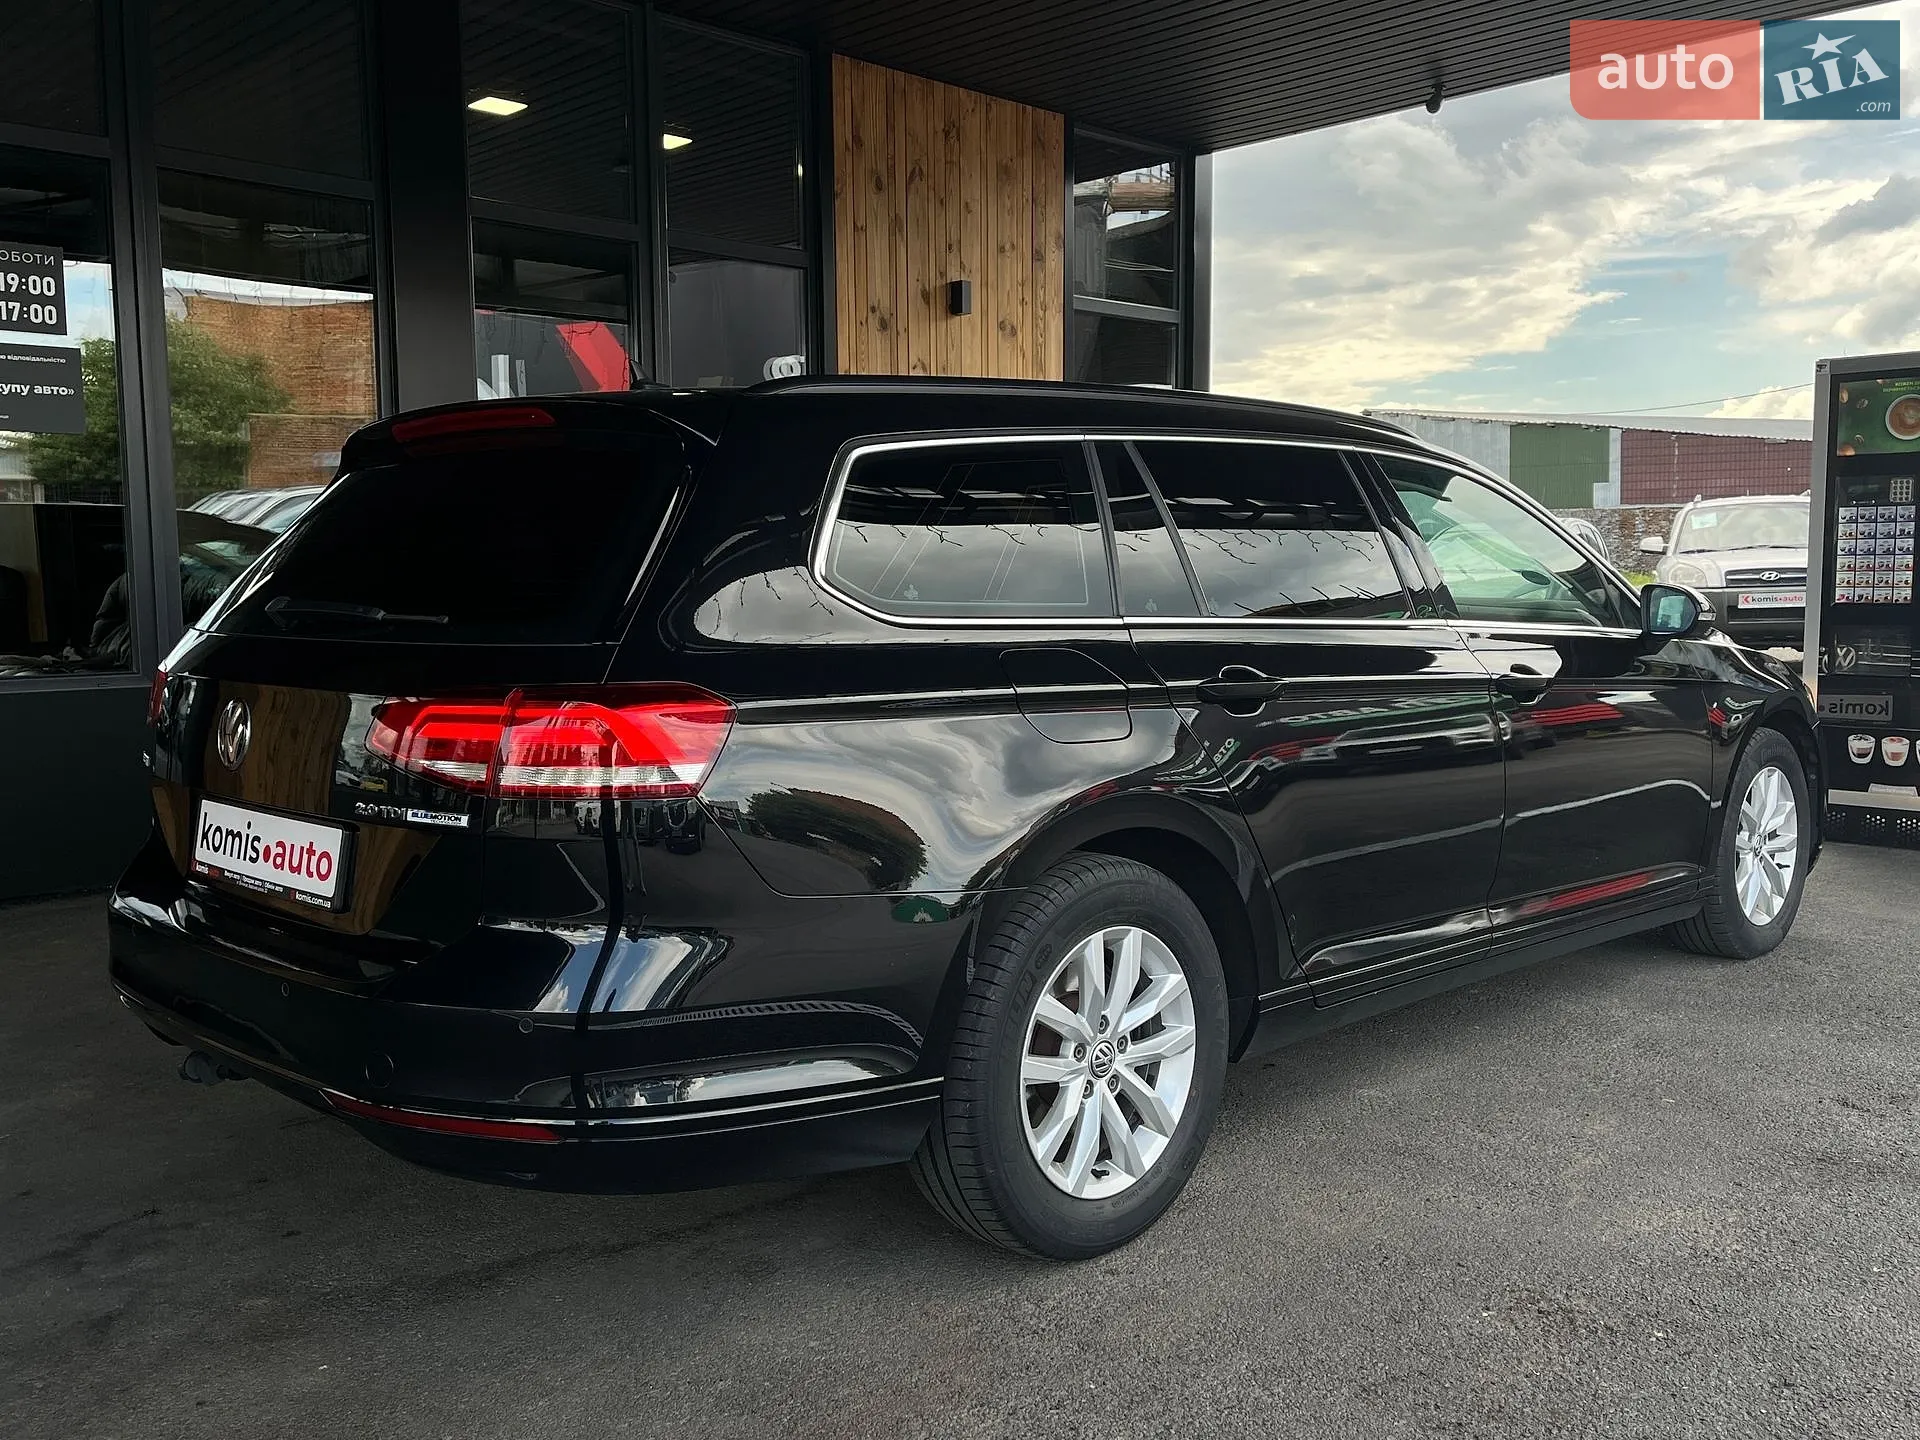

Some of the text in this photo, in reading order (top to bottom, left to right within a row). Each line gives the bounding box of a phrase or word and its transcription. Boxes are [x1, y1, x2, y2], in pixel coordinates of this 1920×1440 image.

[0, 272, 56, 297] 19:00
[0, 301, 58, 325] 17:00
[354, 802, 407, 821] 2.0 TDI
[295, 891, 332, 909] komis.com.ua
